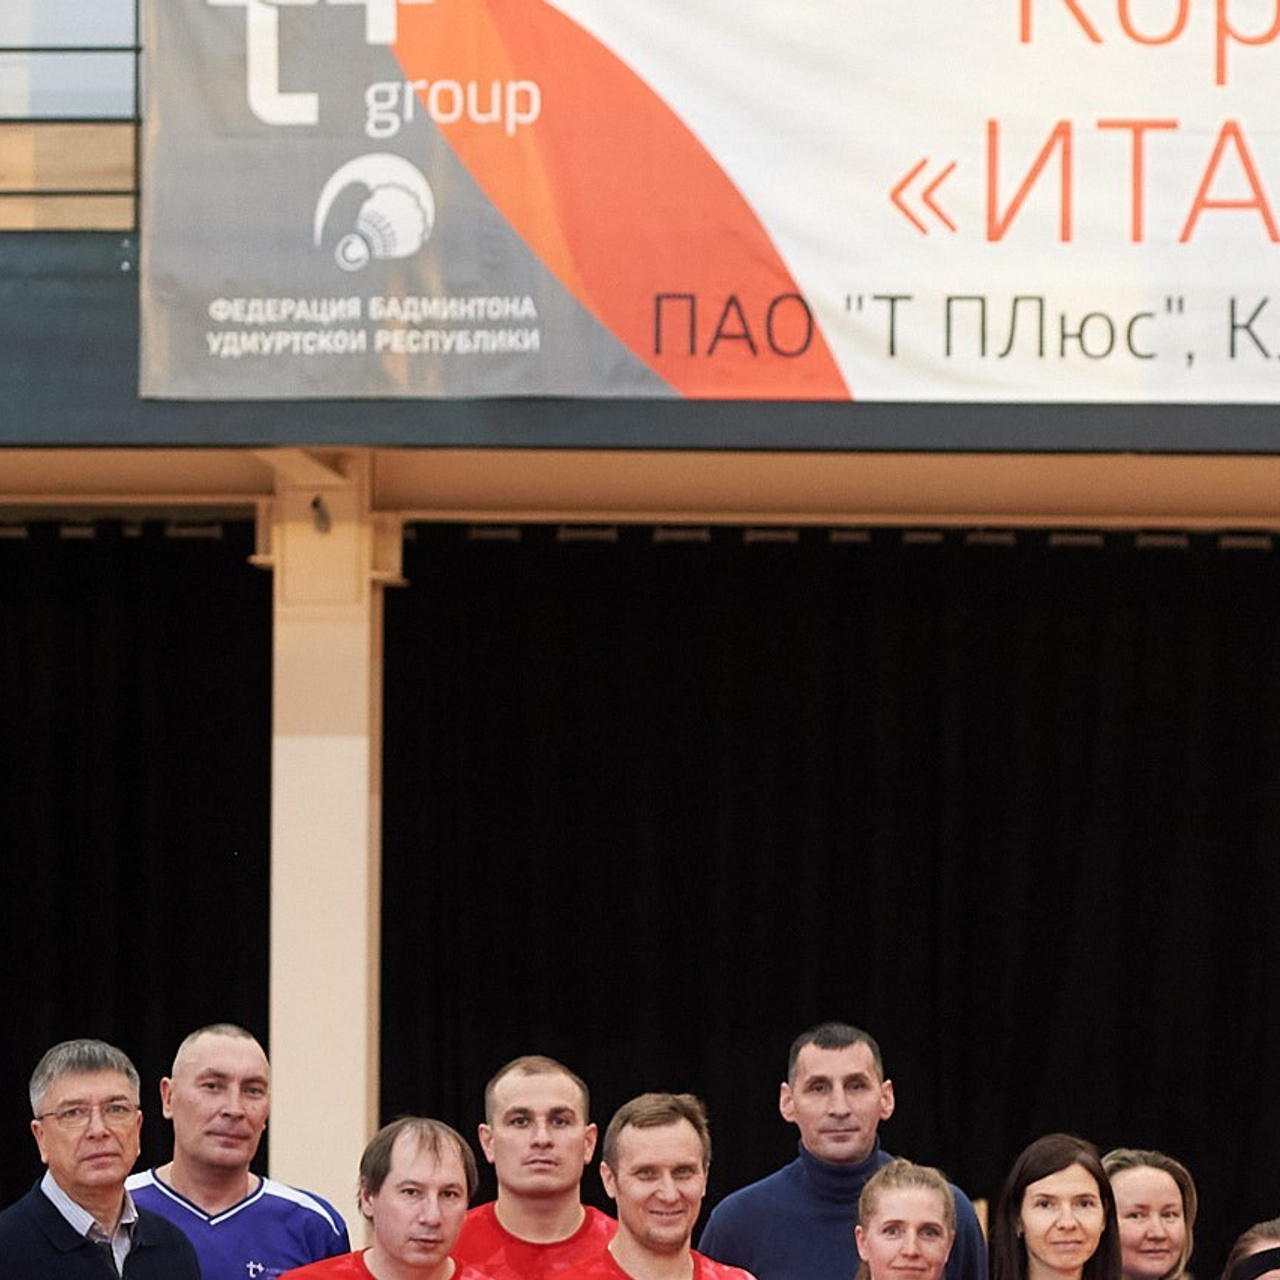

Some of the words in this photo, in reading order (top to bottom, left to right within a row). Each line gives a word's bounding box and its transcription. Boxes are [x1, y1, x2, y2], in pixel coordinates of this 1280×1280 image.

[364, 79, 542, 138] group
[208, 296, 361, 324] ФЕДЕРАЦИЯ
[368, 296, 537, 322] БАДМИНТОНА
[654, 294, 814, 356] ПАО
[374, 329, 540, 354] РЕСПУБЛИКИ
